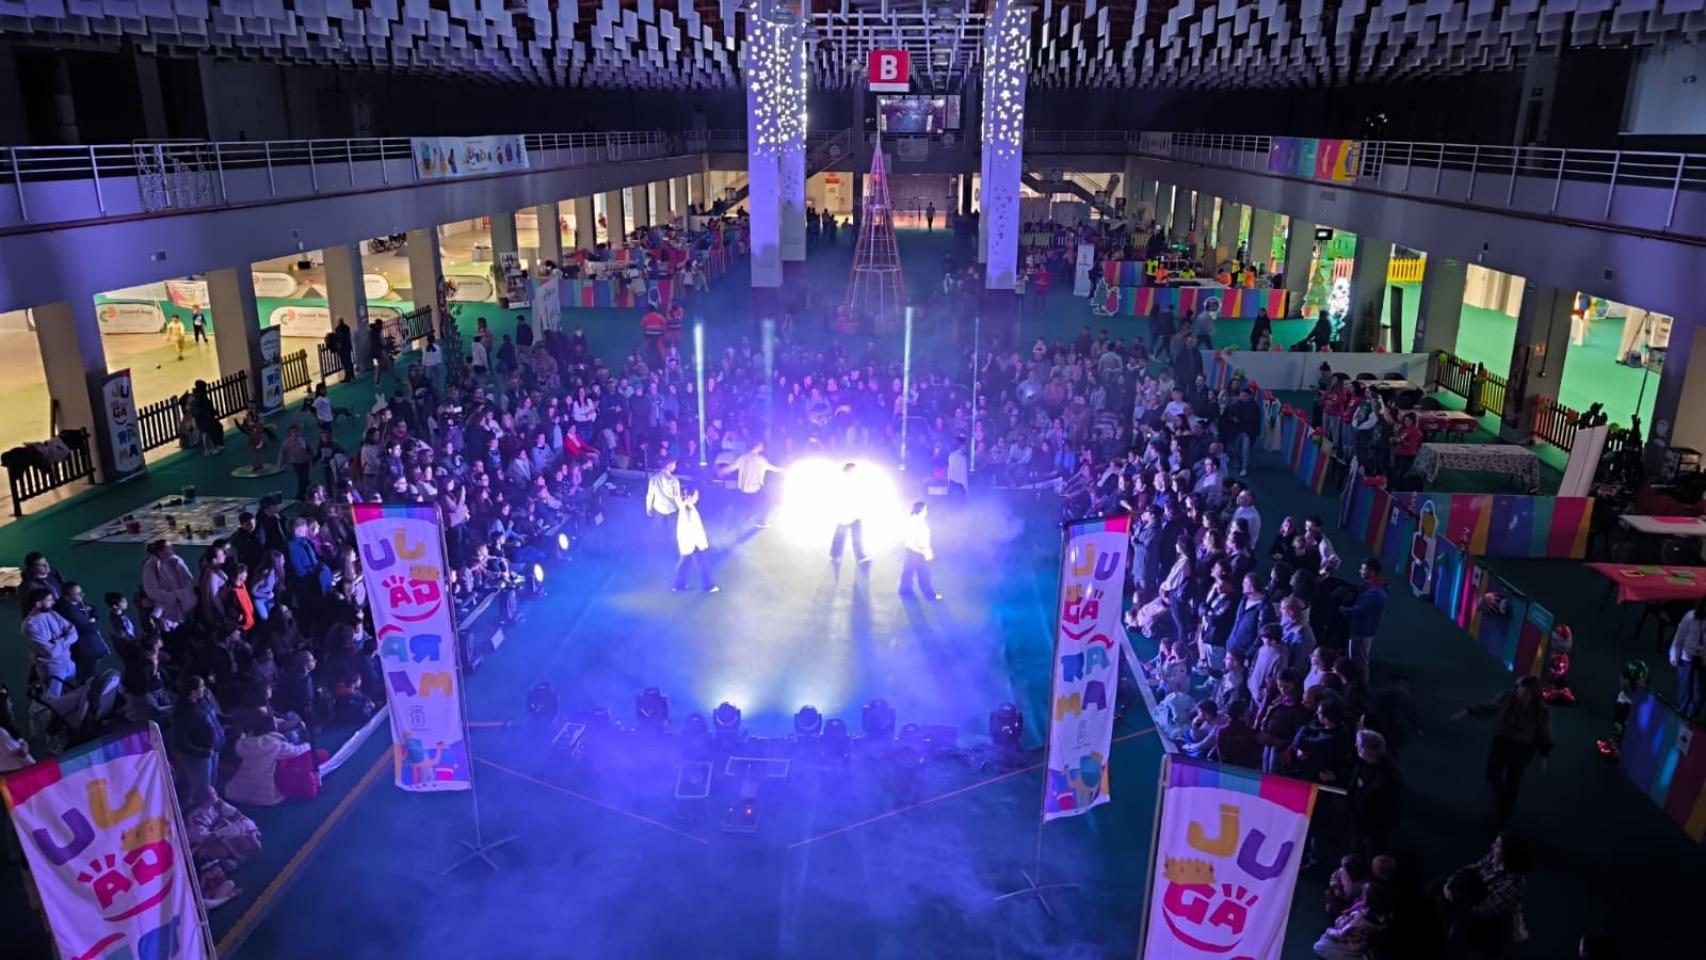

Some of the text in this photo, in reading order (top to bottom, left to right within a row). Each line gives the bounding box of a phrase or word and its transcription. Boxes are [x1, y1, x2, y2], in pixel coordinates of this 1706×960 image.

[880, 55, 898, 80] B
[1072, 543, 1120, 580] JU
[1063, 599, 1100, 625] GA
[1187, 804, 1294, 880] JU
[1164, 882, 1247, 935] GA
